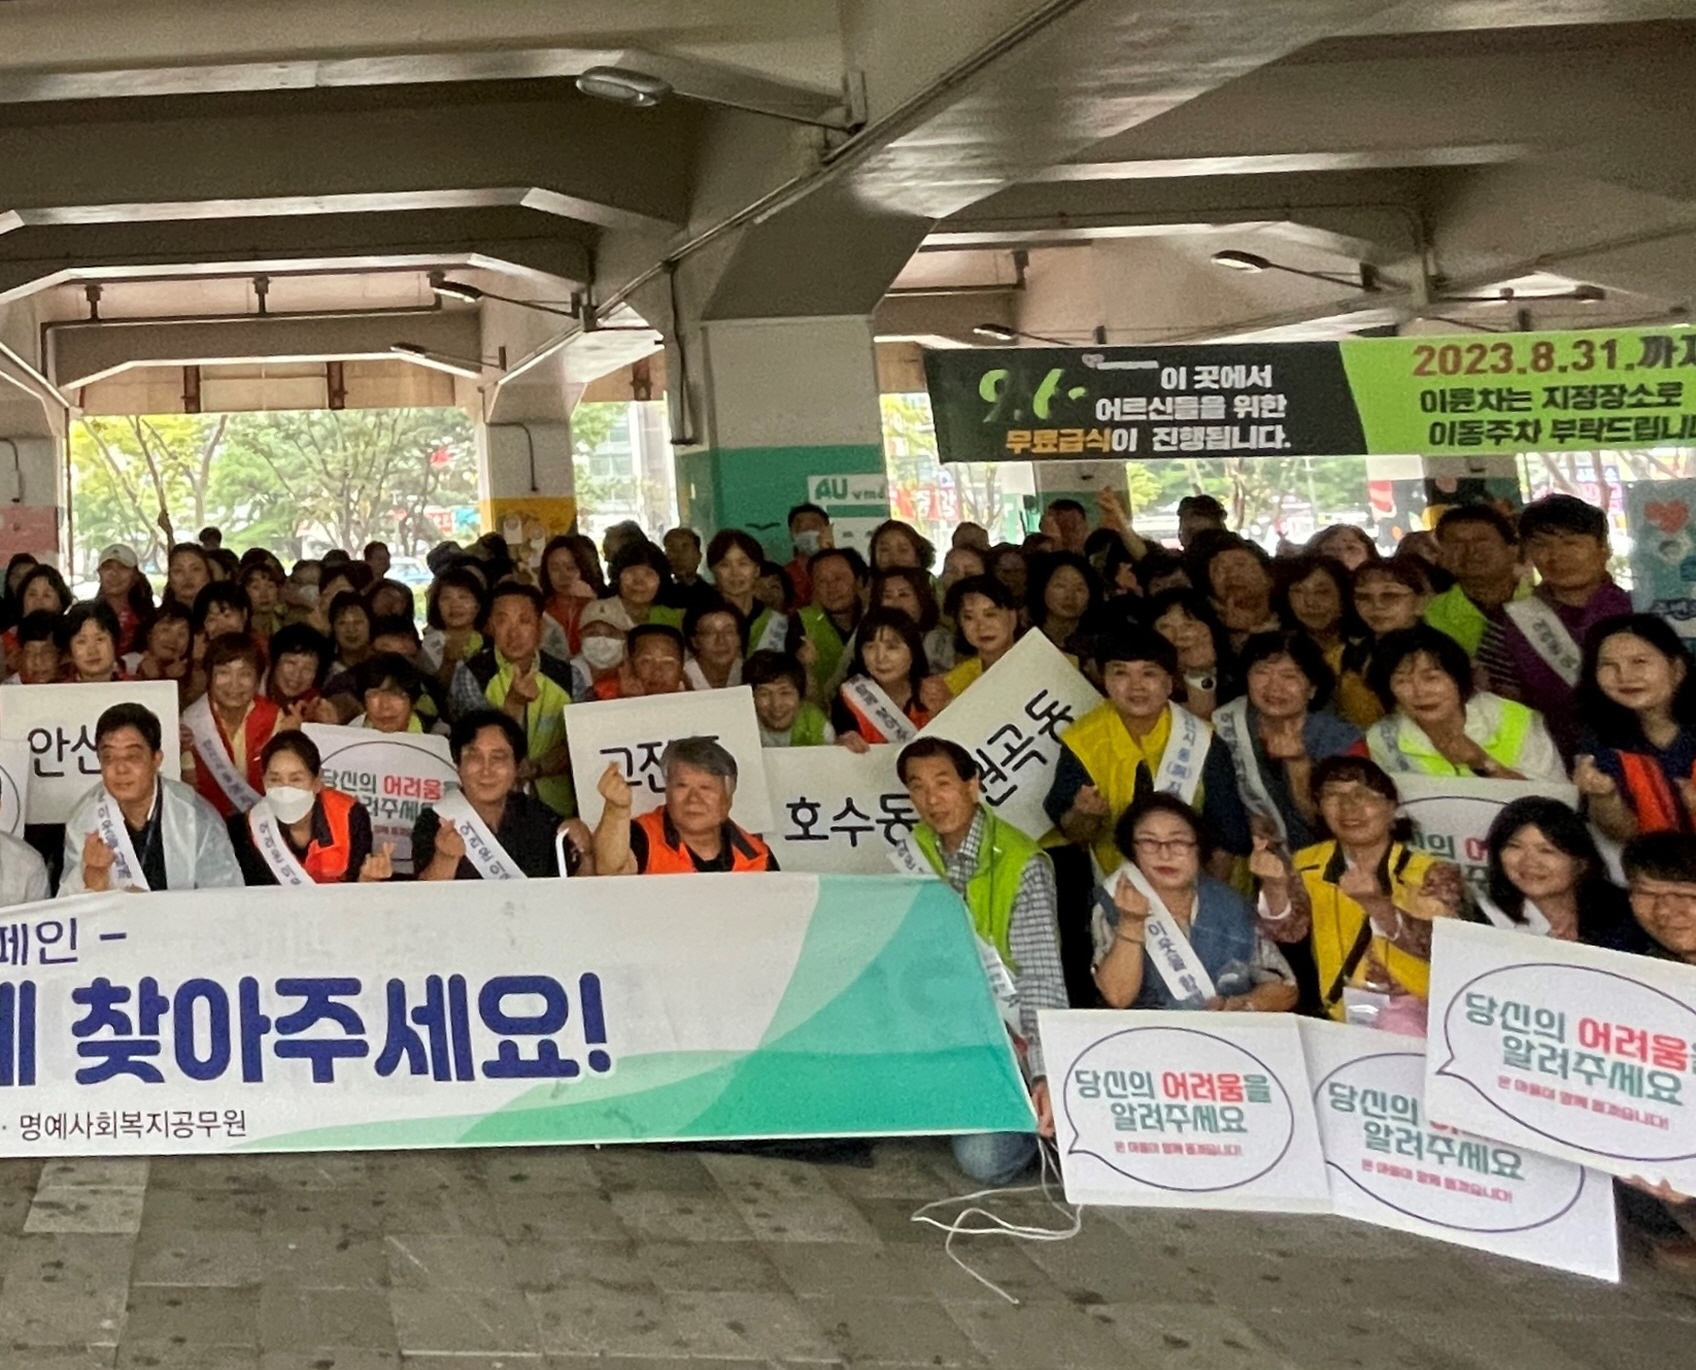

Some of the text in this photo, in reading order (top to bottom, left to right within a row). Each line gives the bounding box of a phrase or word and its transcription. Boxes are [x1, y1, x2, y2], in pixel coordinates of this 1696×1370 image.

[1160, 363, 1273, 390] 이 곳에서
[1095, 394, 1288, 421] 어르신들을 위한
[1420, 381, 1684, 413] 이륜차는 지정장소로
[1006, 425, 1292, 454] 무료급식이 진행됩니다.
[1428, 414, 1696, 447] 이동주차 부탁드립니
[27, 725, 101, 778] 안산
[785, 794, 918, 847] 호수동
[71, 972, 612, 1086] 찾아주세요!
[1464, 991, 1696, 1075] 당신의 어려움
[1075, 1069, 1272, 1103] 당신의 어려움을
[1502, 1033, 1684, 1107] 알려주세요
[1110, 1102, 1248, 1134] 알려주세요
[1328, 1082, 1418, 1126] 당신의
[19, 1109, 247, 1142] 명예사회복지공무원
[1363, 1120, 1526, 1180] 알려주세요
